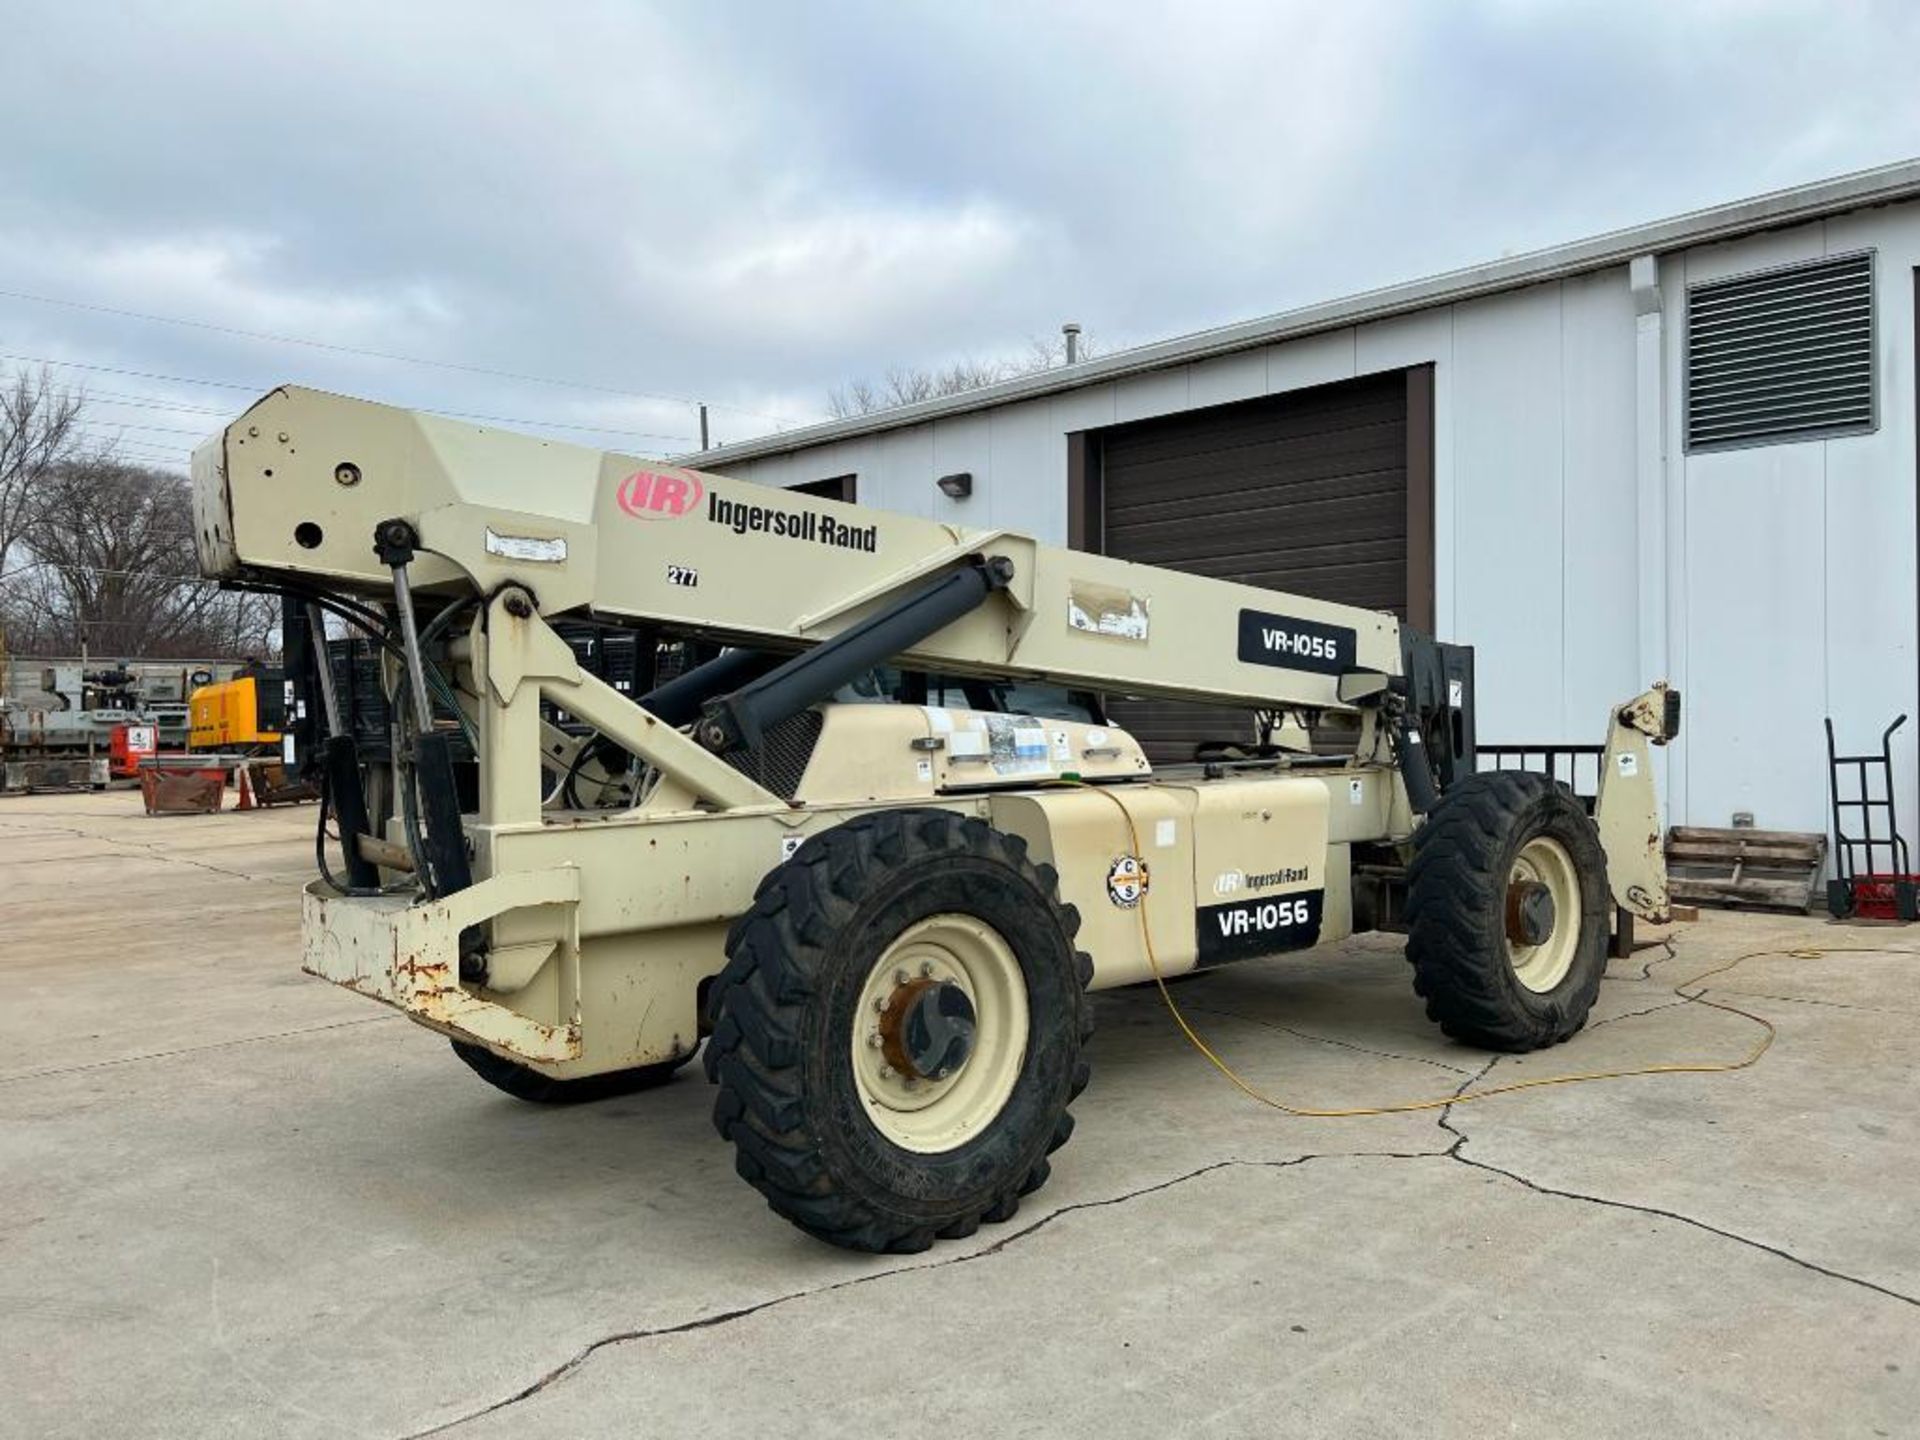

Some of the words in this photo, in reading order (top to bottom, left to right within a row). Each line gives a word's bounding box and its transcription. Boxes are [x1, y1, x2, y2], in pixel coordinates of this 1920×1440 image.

[630, 471, 689, 515] IR
[669, 566, 697, 586] 277
[1262, 628, 1337, 659] VR-1056
[1124, 885, 1134, 898] S
[1217, 899, 1309, 936] VR-1056
